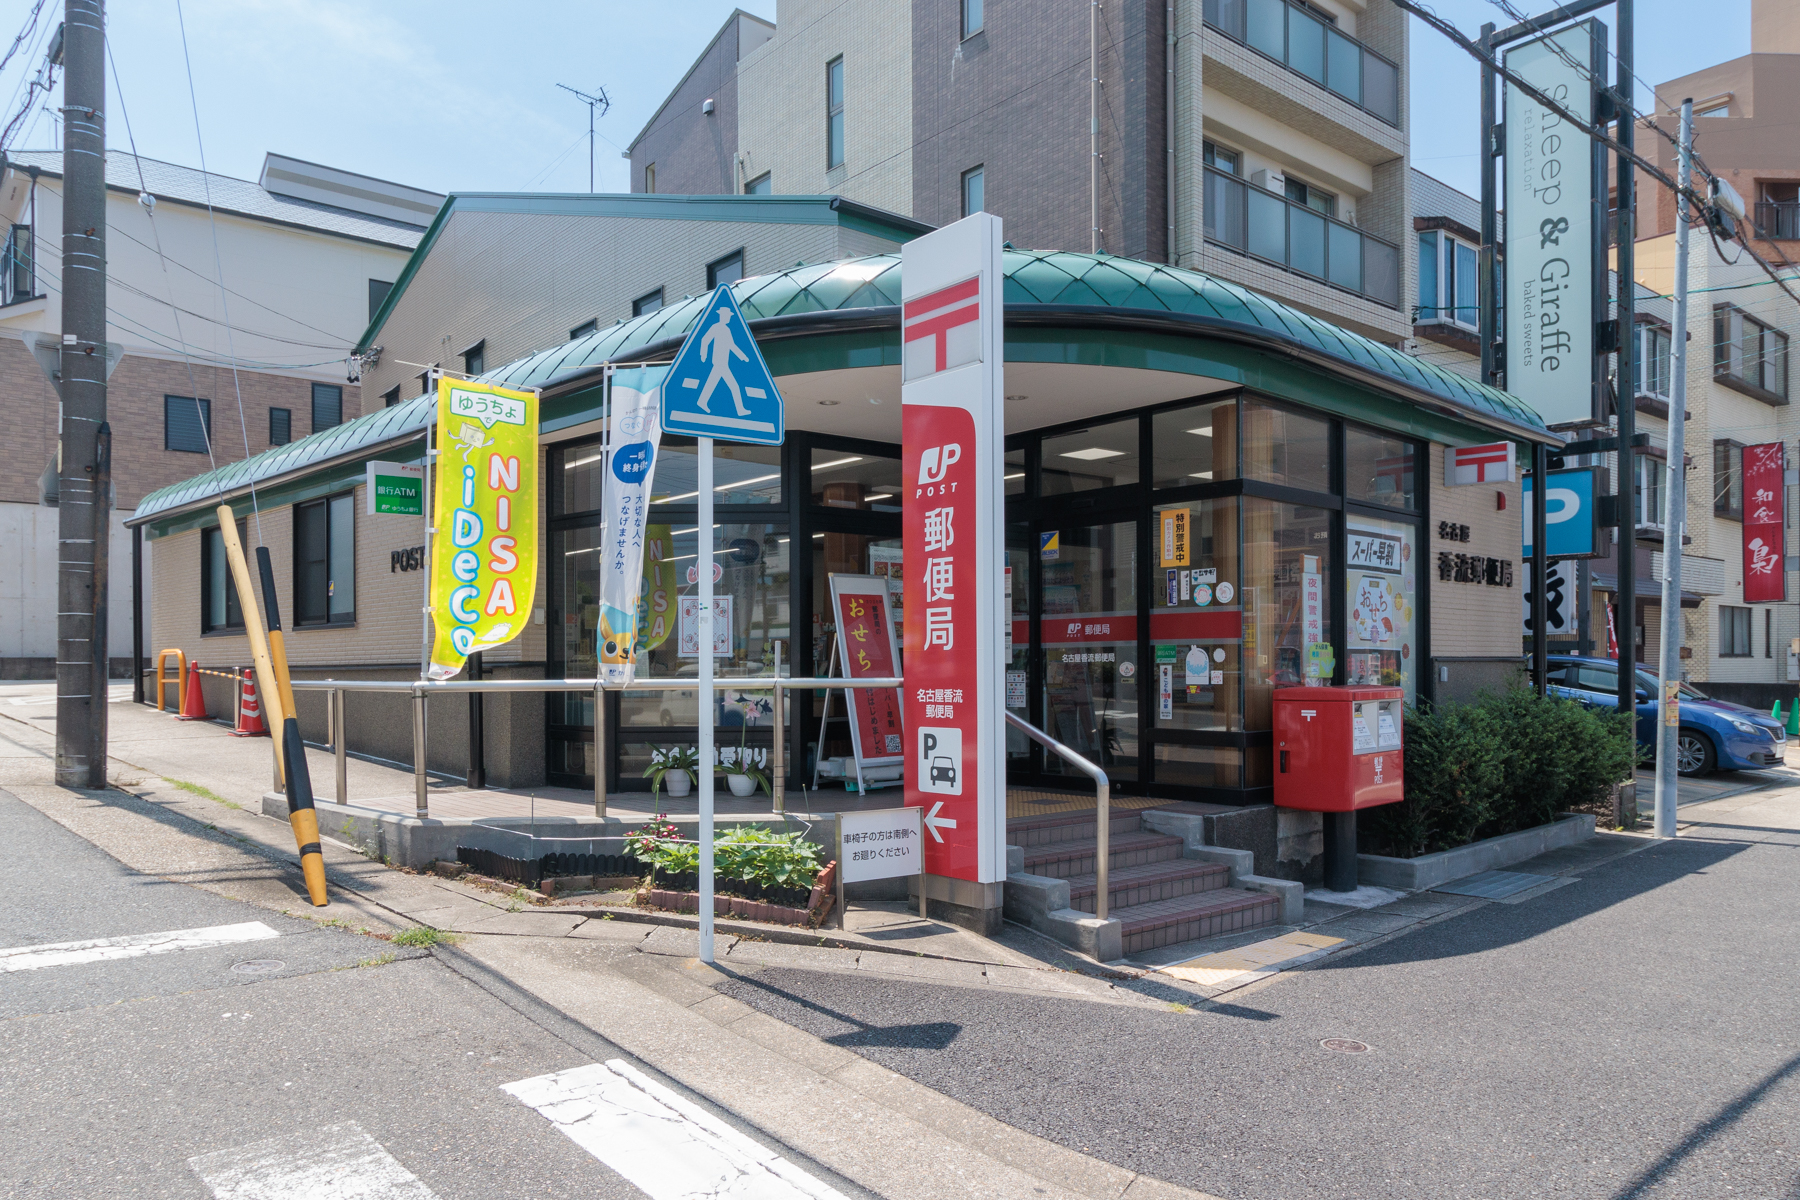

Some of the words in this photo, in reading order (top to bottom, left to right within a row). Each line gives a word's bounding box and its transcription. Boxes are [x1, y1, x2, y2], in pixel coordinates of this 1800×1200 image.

[1523, 107, 1535, 192] relaxation
[1540, 216, 1569, 250] &
[1523, 279, 1535, 318] baked
[1540, 257, 1571, 373] Giraffe
[1523, 322, 1535, 367] sweets
[458, 395, 517, 419] ゆうちょ
[377, 485, 416, 497] 銀行ATM
[916, 482, 957, 499] POST
[1752, 488, 1775, 523] 和食
[631, 493, 643, 547] 大切な人へ
[1438, 520, 1471, 543] 名古屋
[1523, 488, 1580, 546] P
[484, 452, 521, 618] NISA
[614, 495, 631, 575] つなげませんか。
[1175, 513, 1185, 563] 特別警戒中
[390, 545, 425, 573] POST
[448, 464, 484, 657] iDeCo
[1351, 539, 1396, 567] スーパー早割
[1438, 551, 1514, 588] 香流郵便局
[924, 506, 955, 651] 郵便局
[1360, 586, 1388, 623] おせち
[849, 598, 872, 672] おせち
[1084, 624, 1111, 635] 郵便局
[1061, 652, 1116, 663] 名古屋香流郵便局
[916, 688, 963, 703] 名古屋香流
[925, 704, 954, 719] 郵便局
[923, 733, 938, 760] P
[843, 828, 918, 845] 車椅子の方は南側へ
[852, 846, 910, 862] お廻りください
